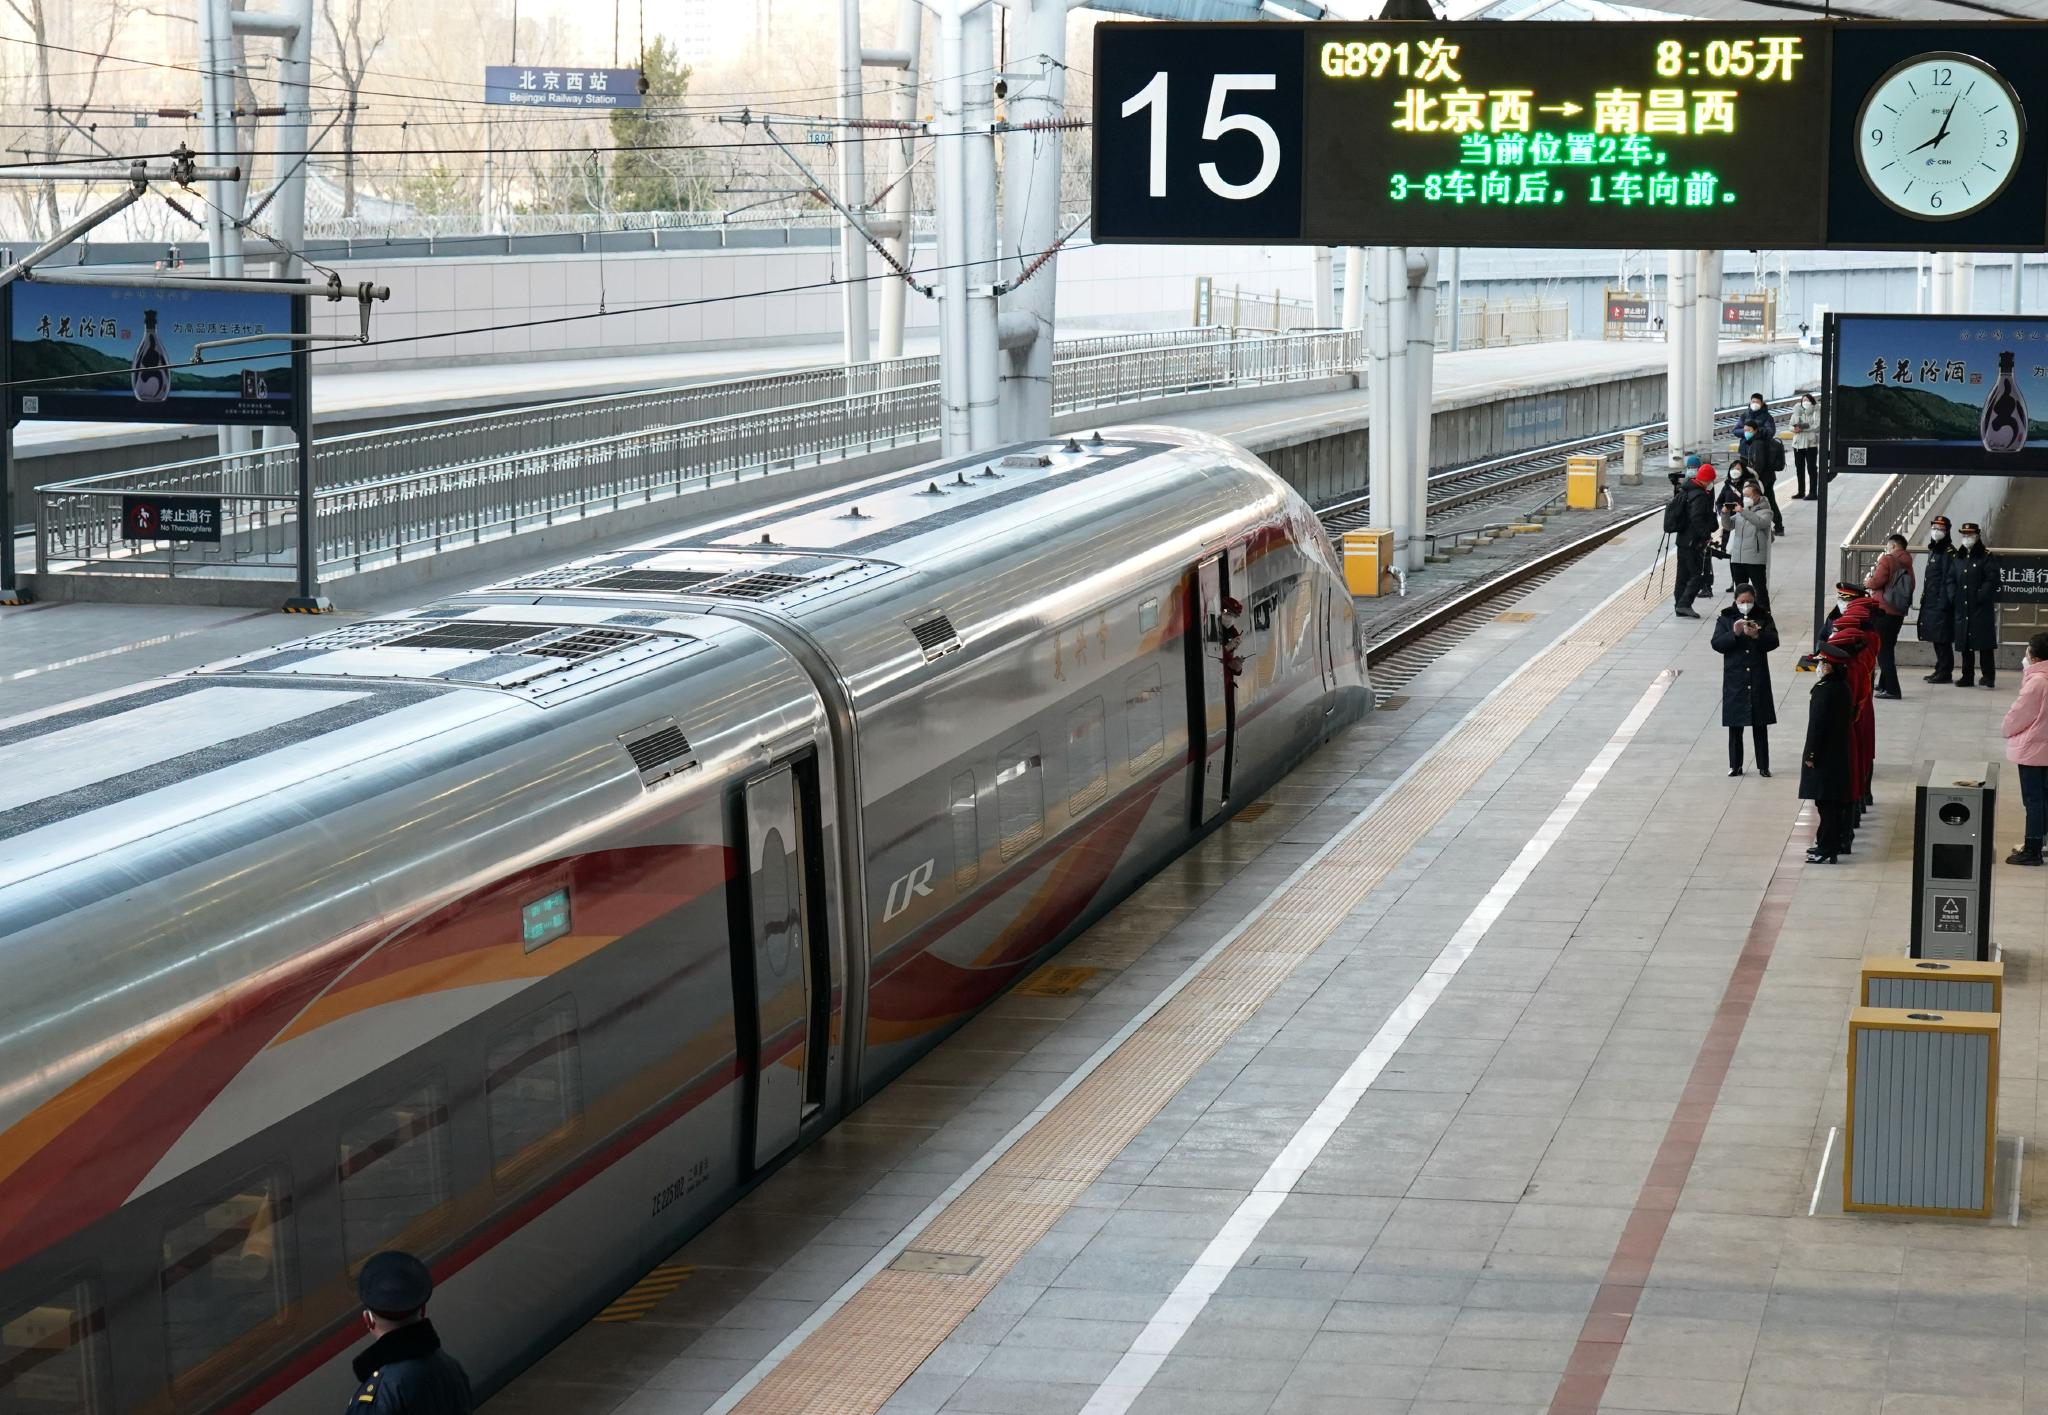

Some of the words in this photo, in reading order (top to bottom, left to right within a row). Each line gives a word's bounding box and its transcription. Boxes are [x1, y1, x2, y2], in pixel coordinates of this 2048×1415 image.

[1321, 40, 1461, 81] G891次
[1655, 37, 1804, 82] 8:05开
[519, 70, 608, 90] 北京西站
[1932, 68, 1952, 86] 12
[509, 91, 546, 103] Beijingxi
[548, 92, 583, 105] Railway
[585, 93, 616, 105] Station
[1391, 88, 1535, 133] 北京西
[1594, 88, 1738, 134] 南昌西
[1121, 72, 1281, 199] 15
[1871, 128, 1883, 147] 9
[1995, 129, 2008, 148] 3
[1930, 190, 1943, 209] 6
[36, 315, 117, 339] 青花汾酒
[172, 323, 265, 335] 为高品质生活代言
[1867, 357, 1966, 385] 青花汾酒
[160, 508, 212, 523] 禁止通行
[171, 525, 212, 533] Thoroughfare
[2003, 585, 2048, 594] Thoroughfar
